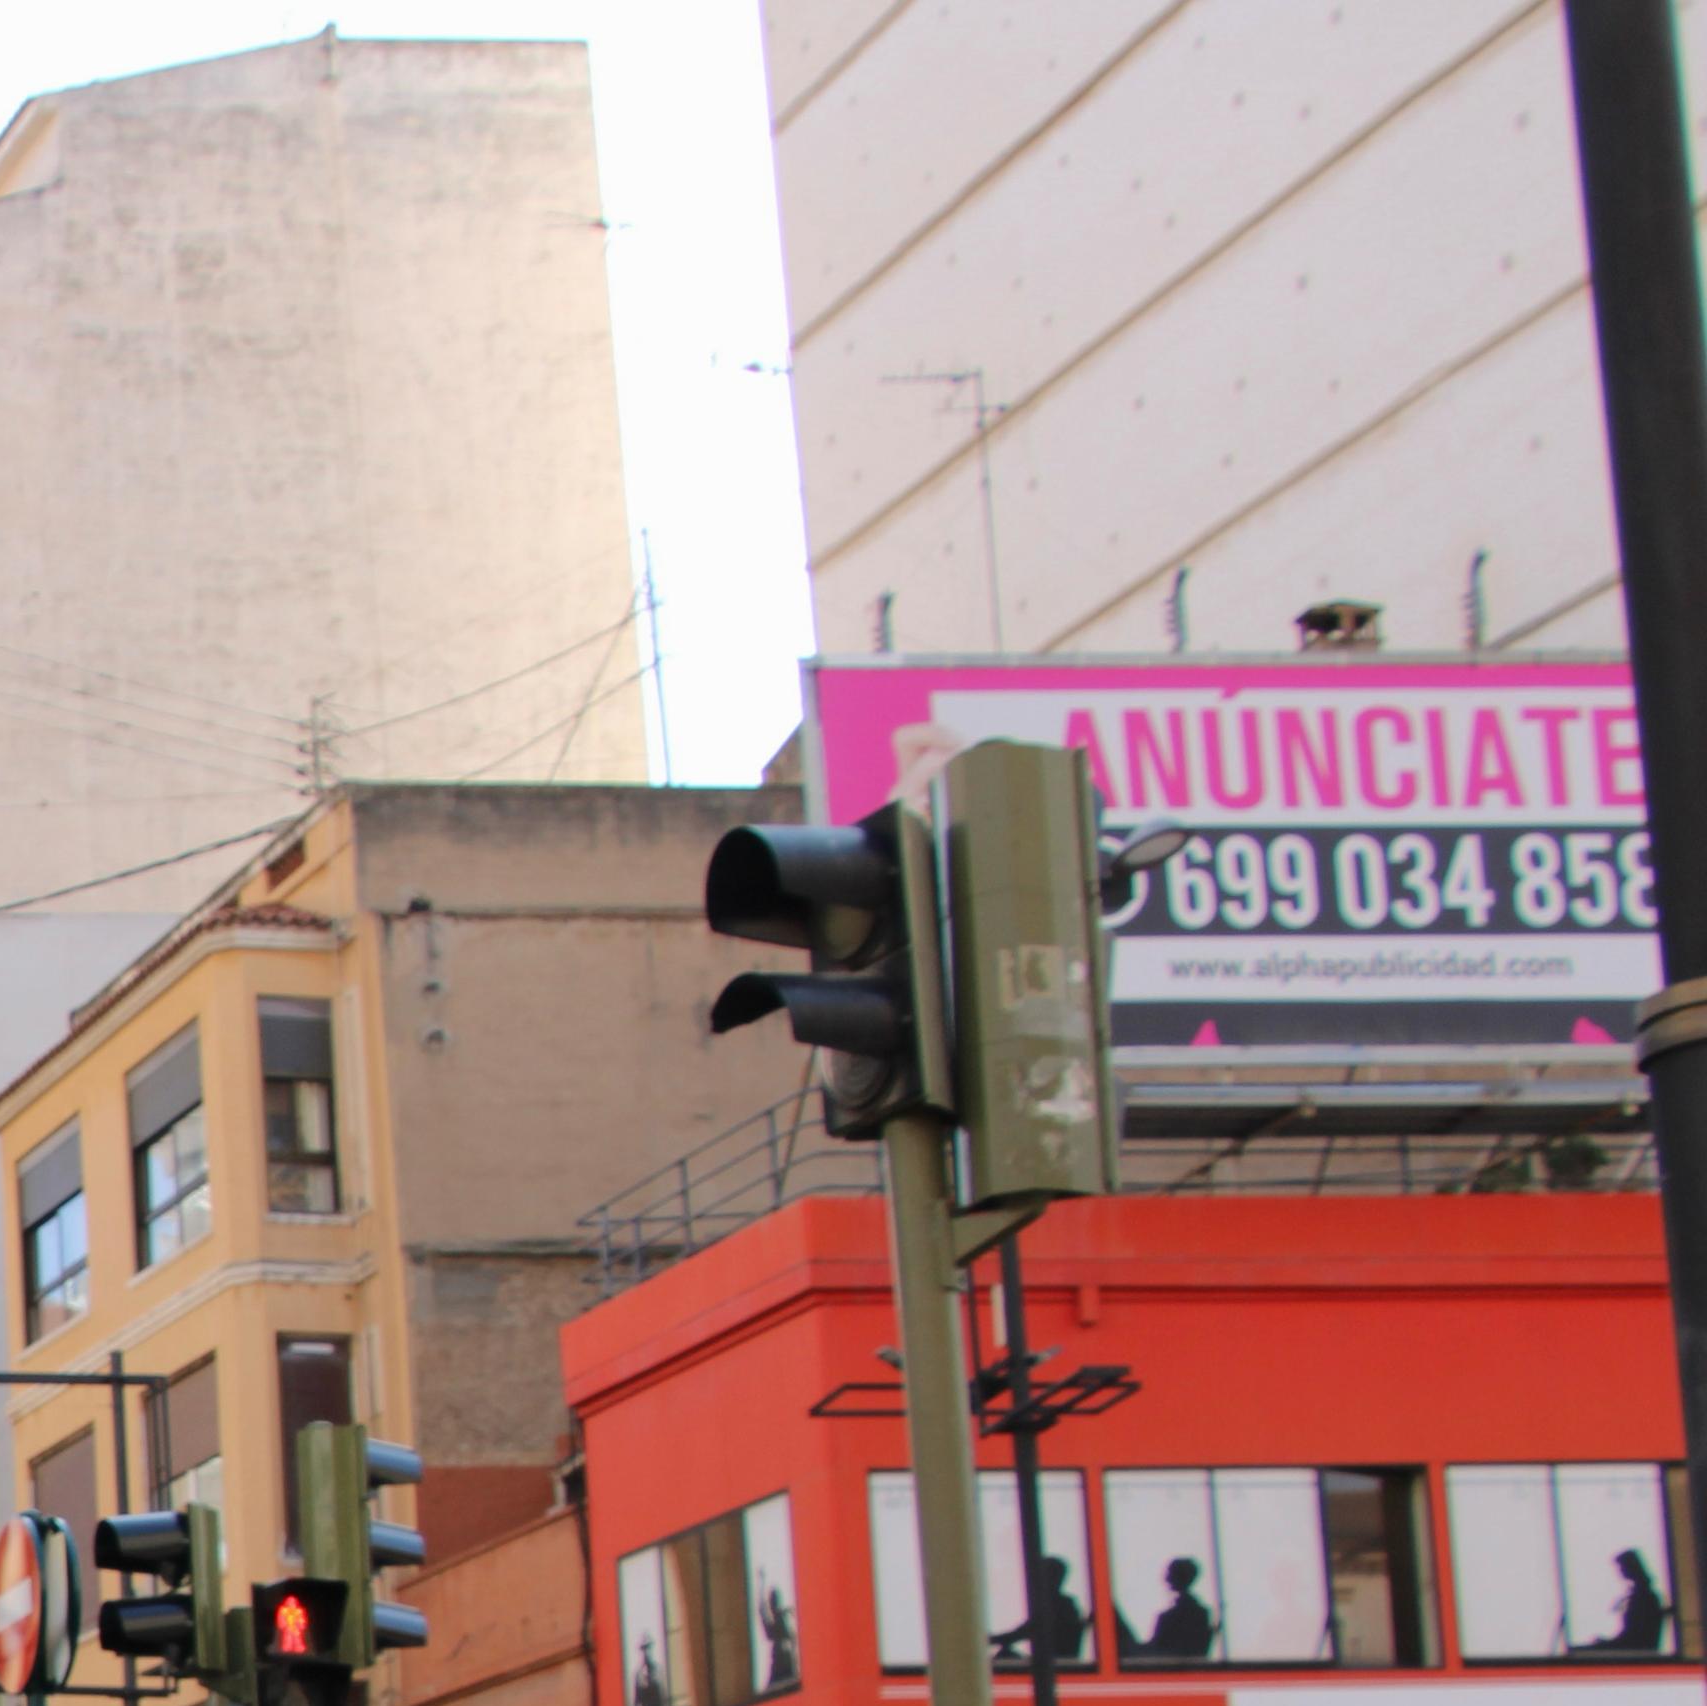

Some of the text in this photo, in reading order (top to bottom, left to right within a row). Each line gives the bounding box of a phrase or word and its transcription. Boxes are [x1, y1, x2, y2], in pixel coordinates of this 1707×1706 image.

[1063, 688, 1645, 808] ANÚNCIATE
[1165, 831, 1660, 929] 699 034 858
[1168, 950, 1575, 982] www.alphapublicidad.com
